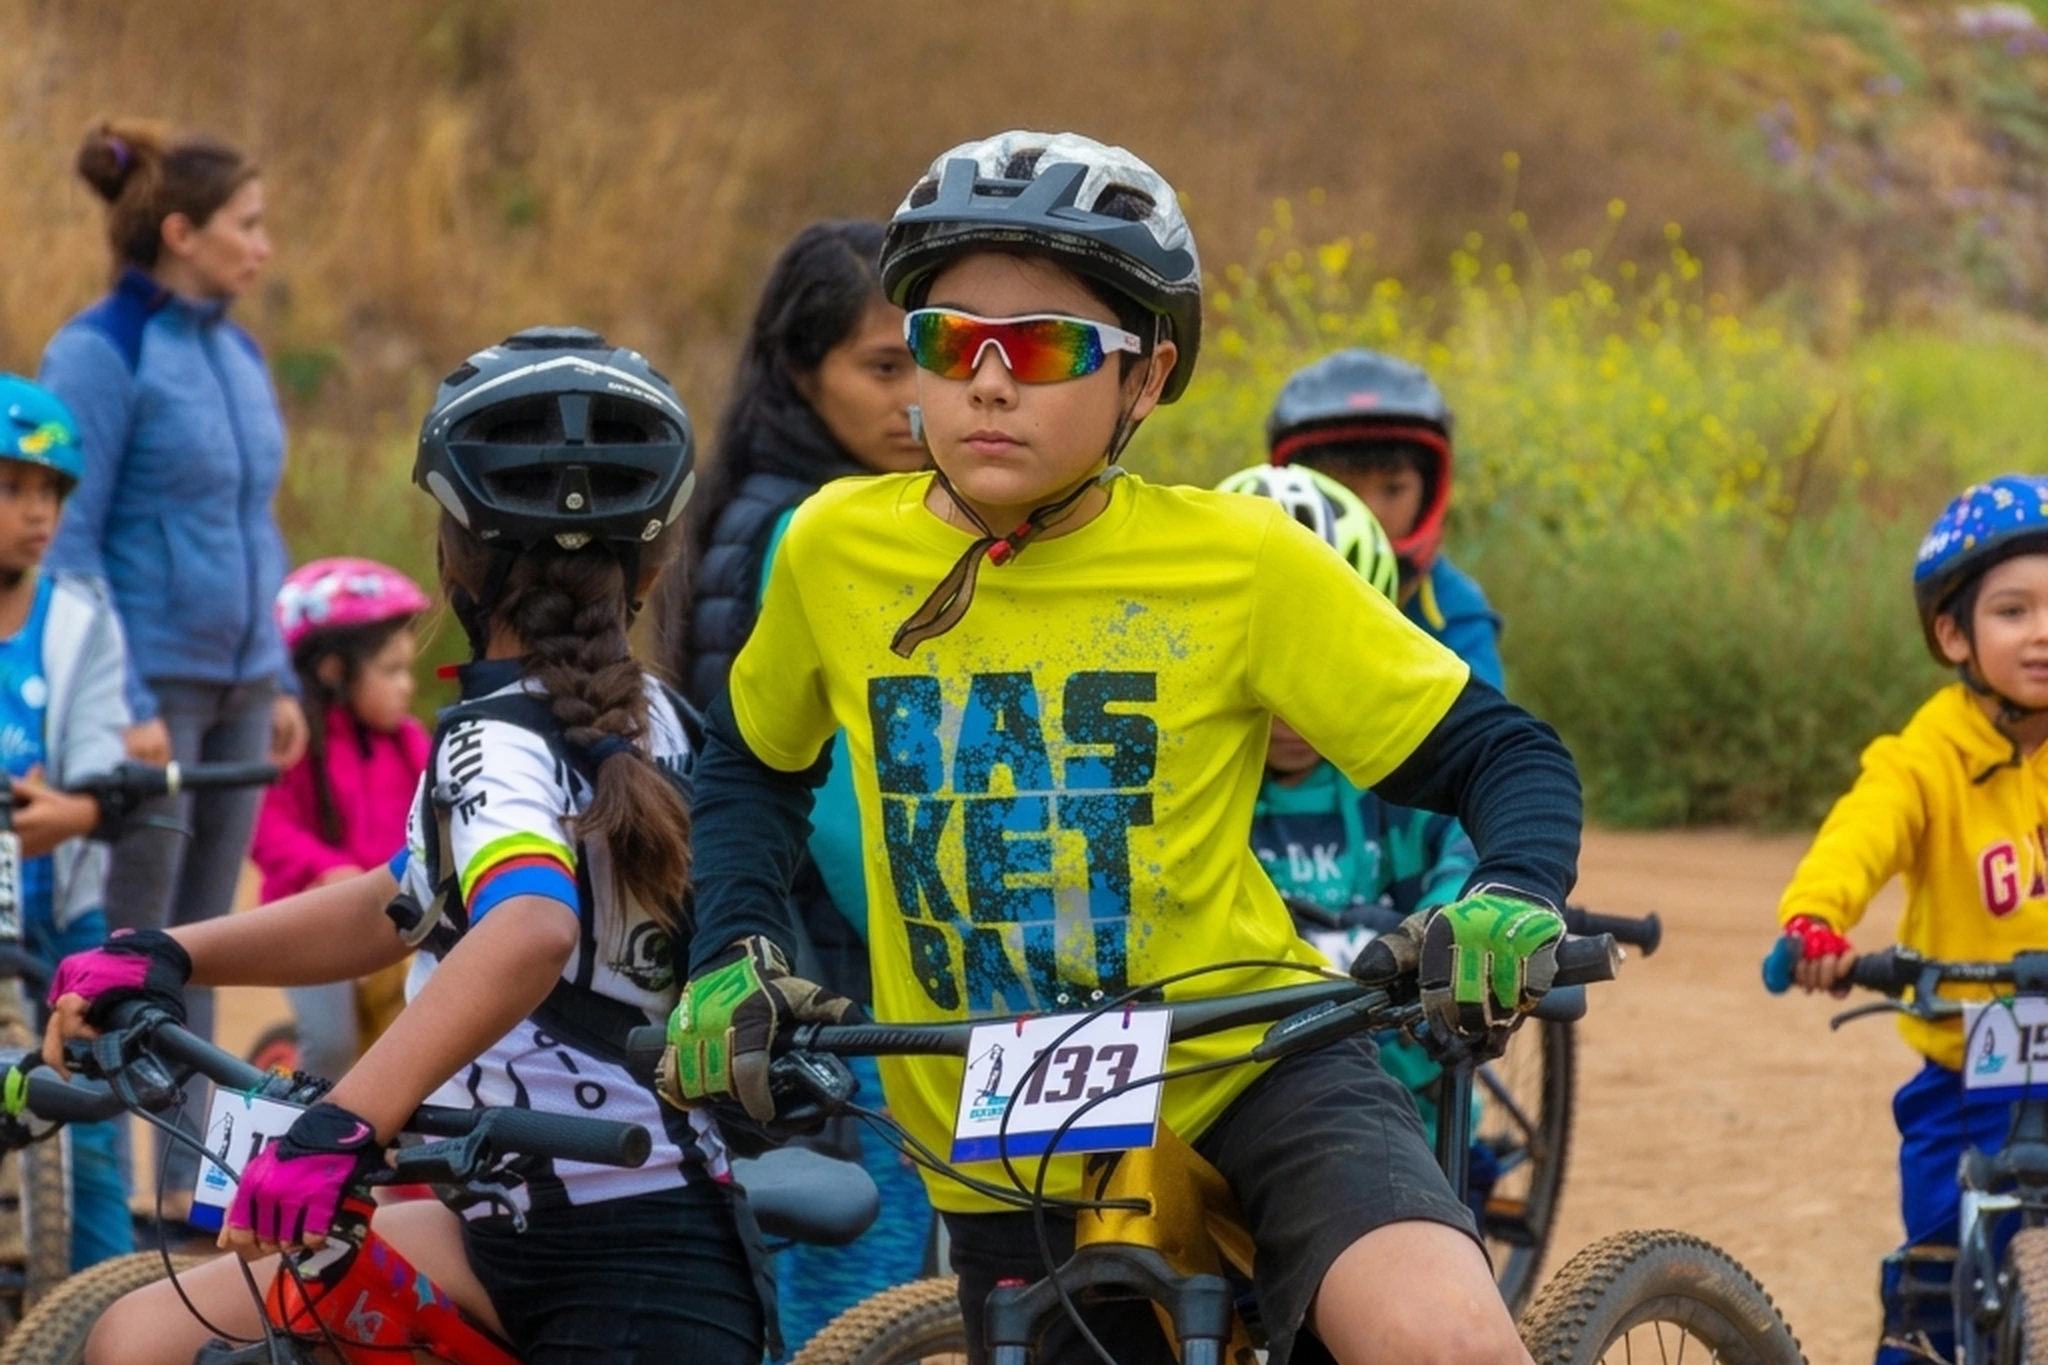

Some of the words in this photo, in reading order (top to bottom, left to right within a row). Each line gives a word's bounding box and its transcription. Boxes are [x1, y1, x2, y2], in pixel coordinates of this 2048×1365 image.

[867, 670, 1158, 794] BAS
[881, 792, 1155, 924] KET
[1023, 1043, 1139, 1106] 133
